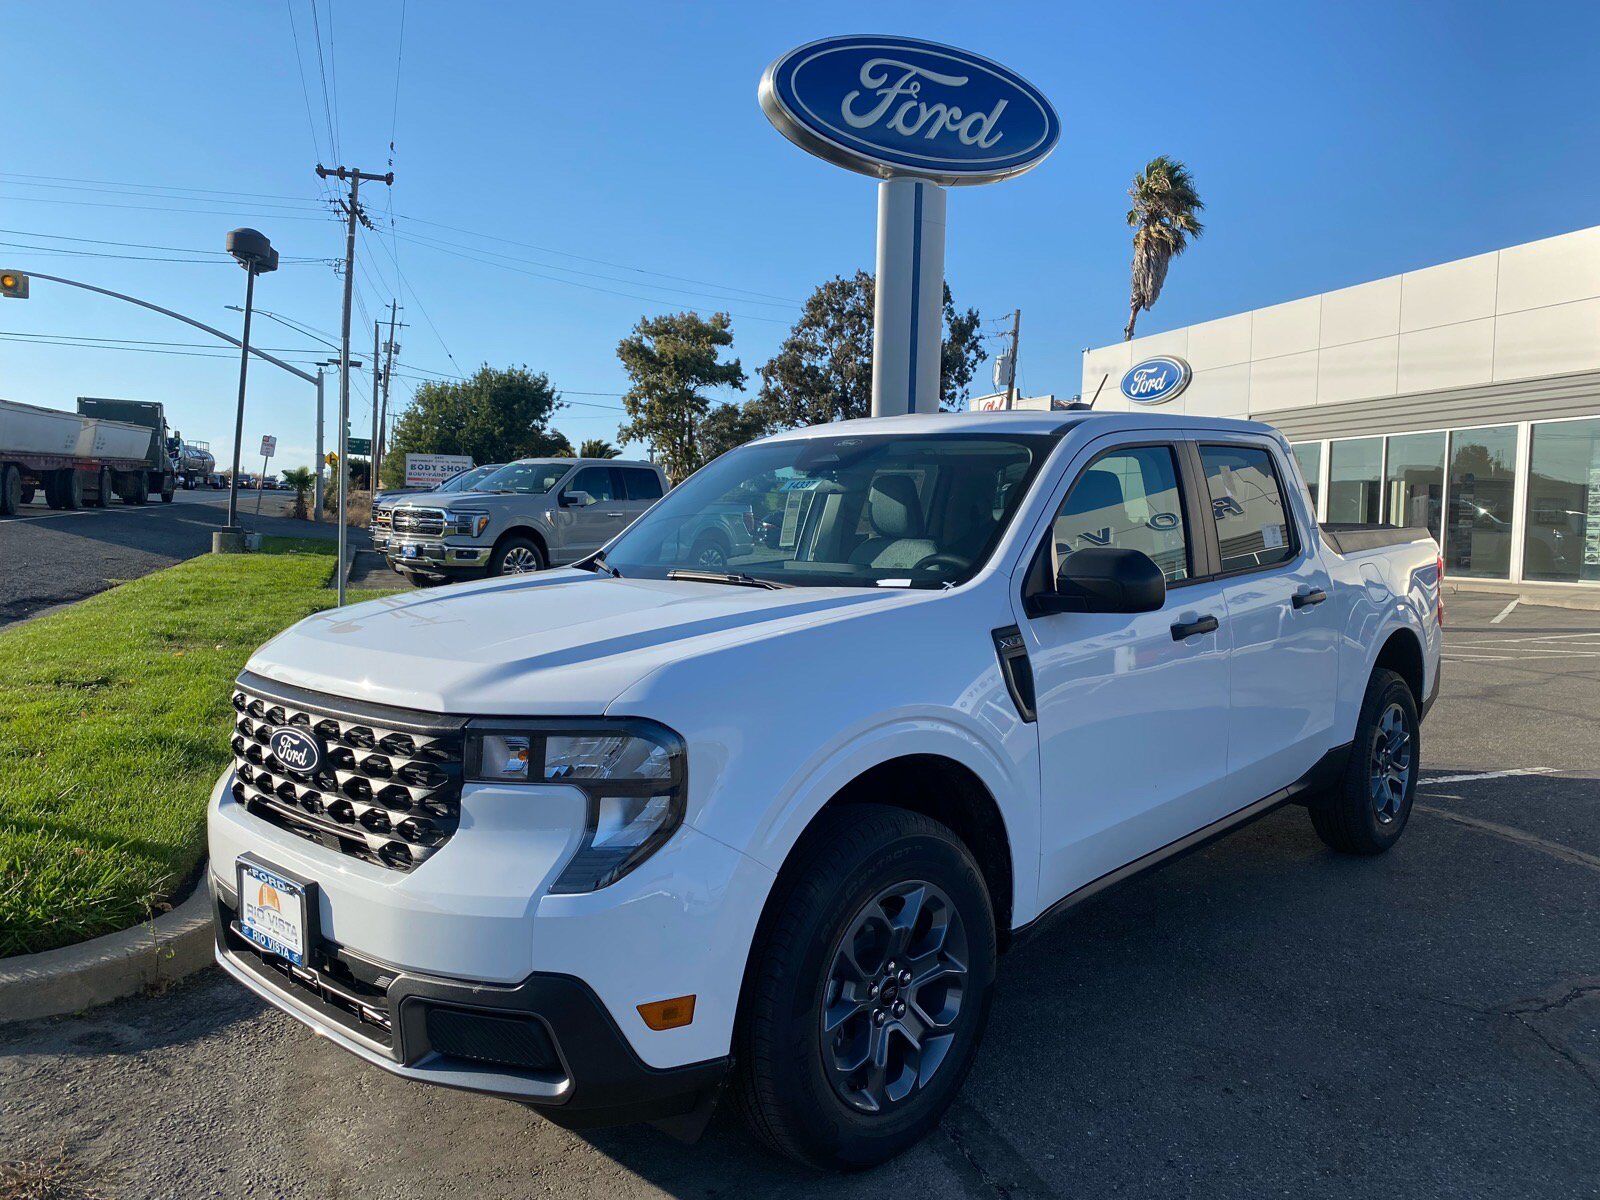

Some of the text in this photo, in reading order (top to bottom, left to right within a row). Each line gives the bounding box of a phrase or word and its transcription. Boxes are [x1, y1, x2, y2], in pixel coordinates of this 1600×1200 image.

[840, 57, 1009, 149] Ford
[1130, 366, 1168, 396] Ford
[277, 734, 308, 766] Ford
[251, 868, 286, 891] FORD
[246, 902, 298, 938] RIO VISTA
[252, 930, 290, 960] RIO VISTA
